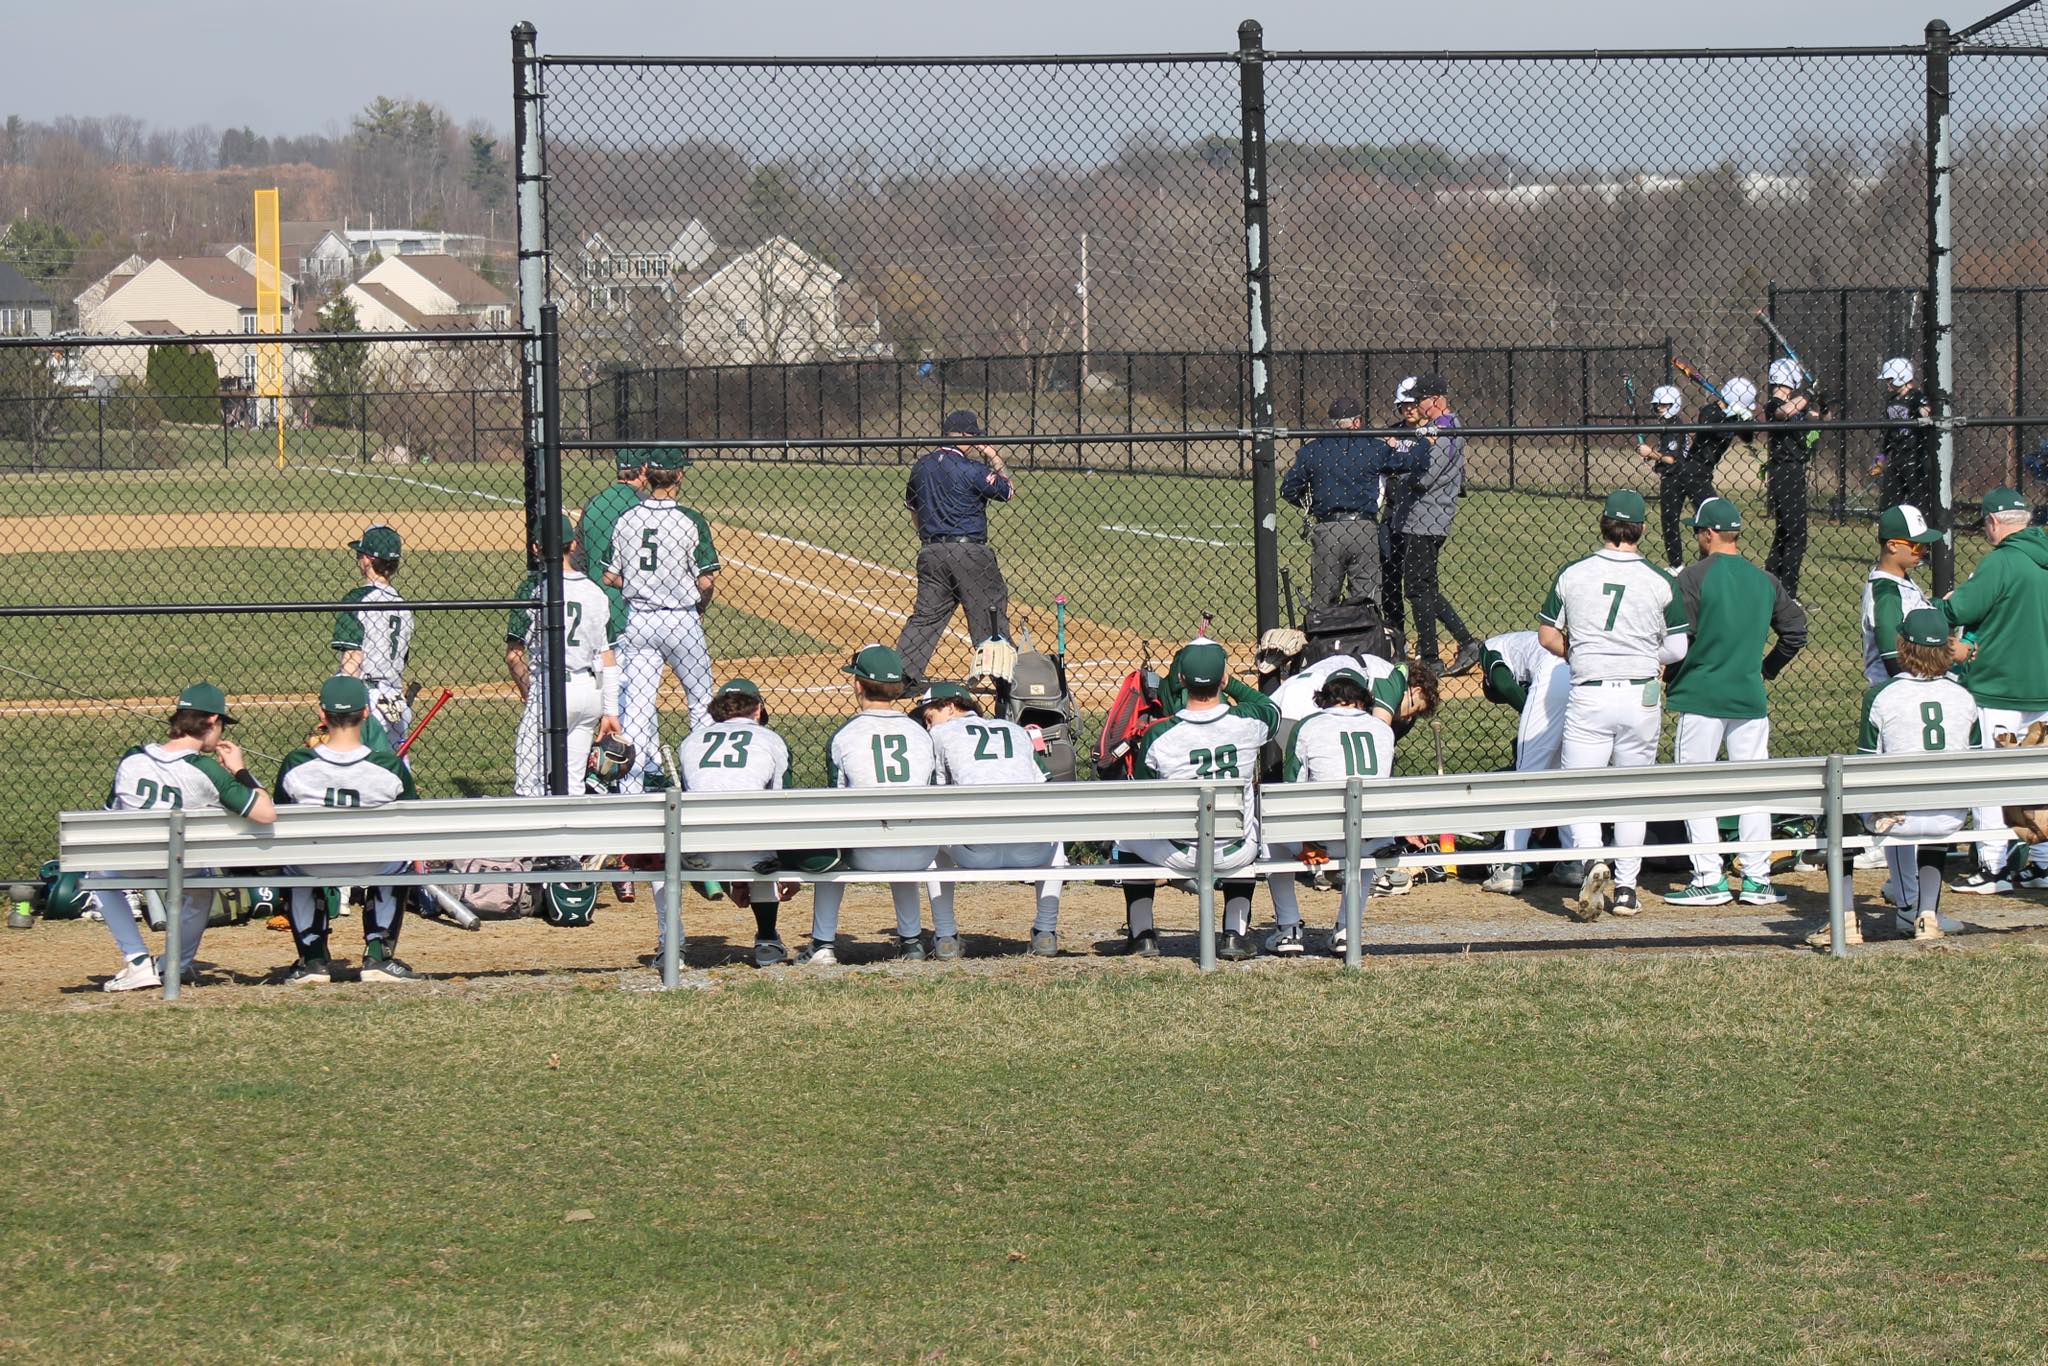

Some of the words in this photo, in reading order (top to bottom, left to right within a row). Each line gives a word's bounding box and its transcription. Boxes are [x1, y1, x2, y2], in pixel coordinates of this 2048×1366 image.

[639, 528, 658, 571] 5
[566, 601, 582, 647] 2
[1602, 582, 1626, 632] 7
[966, 724, 1014, 761] 27
[1919, 701, 1946, 751] 8
[699, 730, 753, 769] 23
[871, 734, 910, 783] 13
[1340, 731, 1378, 776] 10
